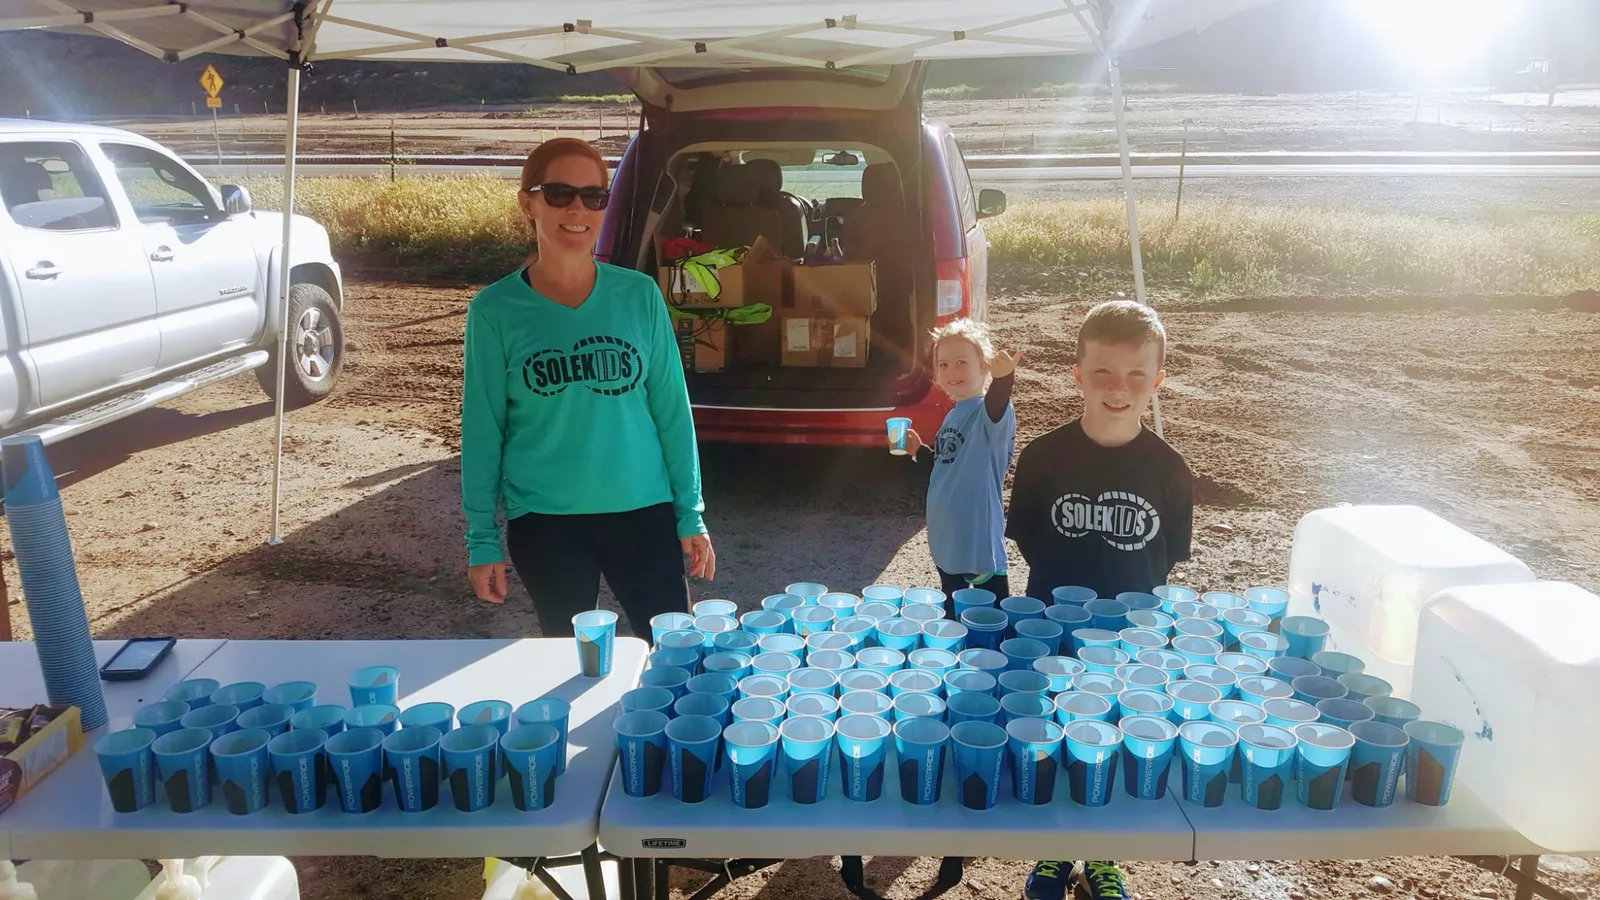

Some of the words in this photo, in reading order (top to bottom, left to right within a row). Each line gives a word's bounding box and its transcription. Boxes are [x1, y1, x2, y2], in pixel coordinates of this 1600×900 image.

[532, 349, 632, 388] SOLEKIDS
[1061, 501, 1147, 537] SOLEKIDS
[299, 757, 310, 809] POWERADE
[341, 758, 356, 810] POWERADE
[402, 757, 415, 809] POWERADE
[475, 754, 483, 807] POWERADE
[528, 755, 537, 807] POWERADE
[629, 740, 637, 794] POWERADE
[731, 748, 741, 803] POWERADE
[852, 744, 861, 797] POWERADE
[923, 748, 934, 801] POWERADE
[1021, 747, 1029, 800] POWERADE
[1092, 749, 1104, 803] POWERADE
[1143, 745, 1155, 797] POWERADE
[1191, 748, 1201, 802] POWERADE
[1382, 751, 1399, 804] POWERADE
